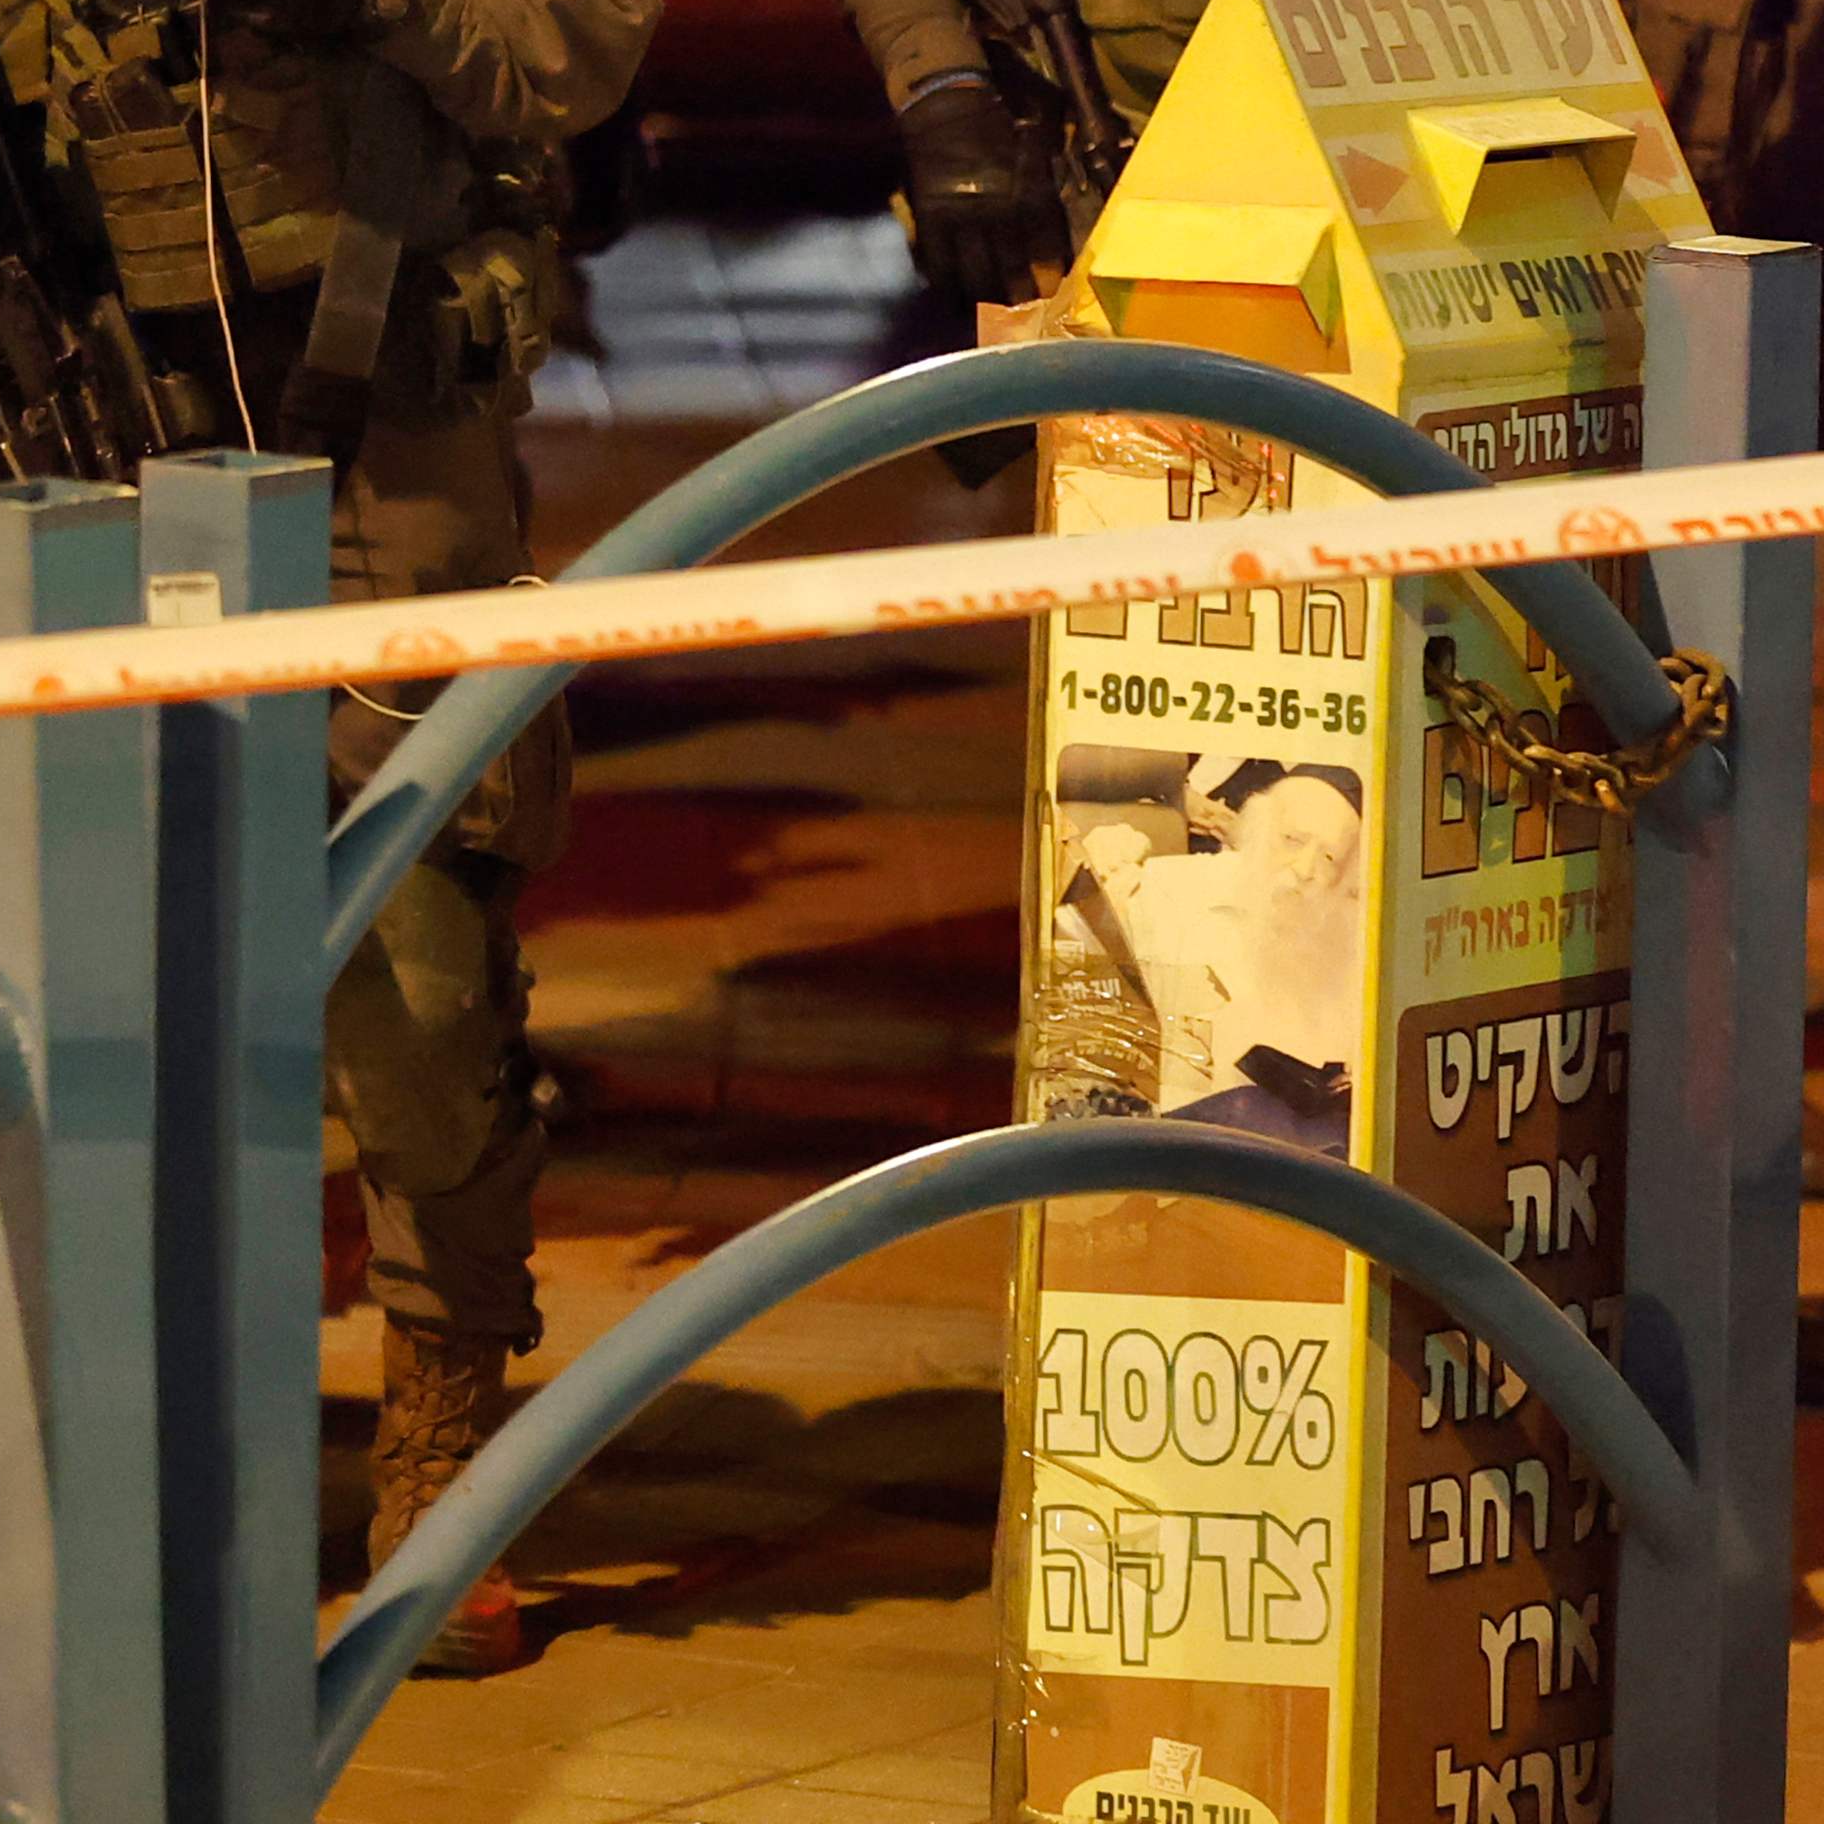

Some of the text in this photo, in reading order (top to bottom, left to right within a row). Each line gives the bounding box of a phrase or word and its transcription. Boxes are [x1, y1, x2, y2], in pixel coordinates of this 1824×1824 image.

[1499, 255, 1613, 319] ורואים
[1502, 406, 1569, 467] גדולי
[1573, 397, 1614, 458] של
[1060, 669, 1367, 736] 1-800-22-36-36
[1503, 1153, 1598, 1263] את
[1037, 1327, 1336, 1470] 100%
[1407, 1458, 1550, 1576] רחבי
[1040, 1502, 1332, 1668] צדקה
[1479, 1591, 1600, 1732] ארץ
